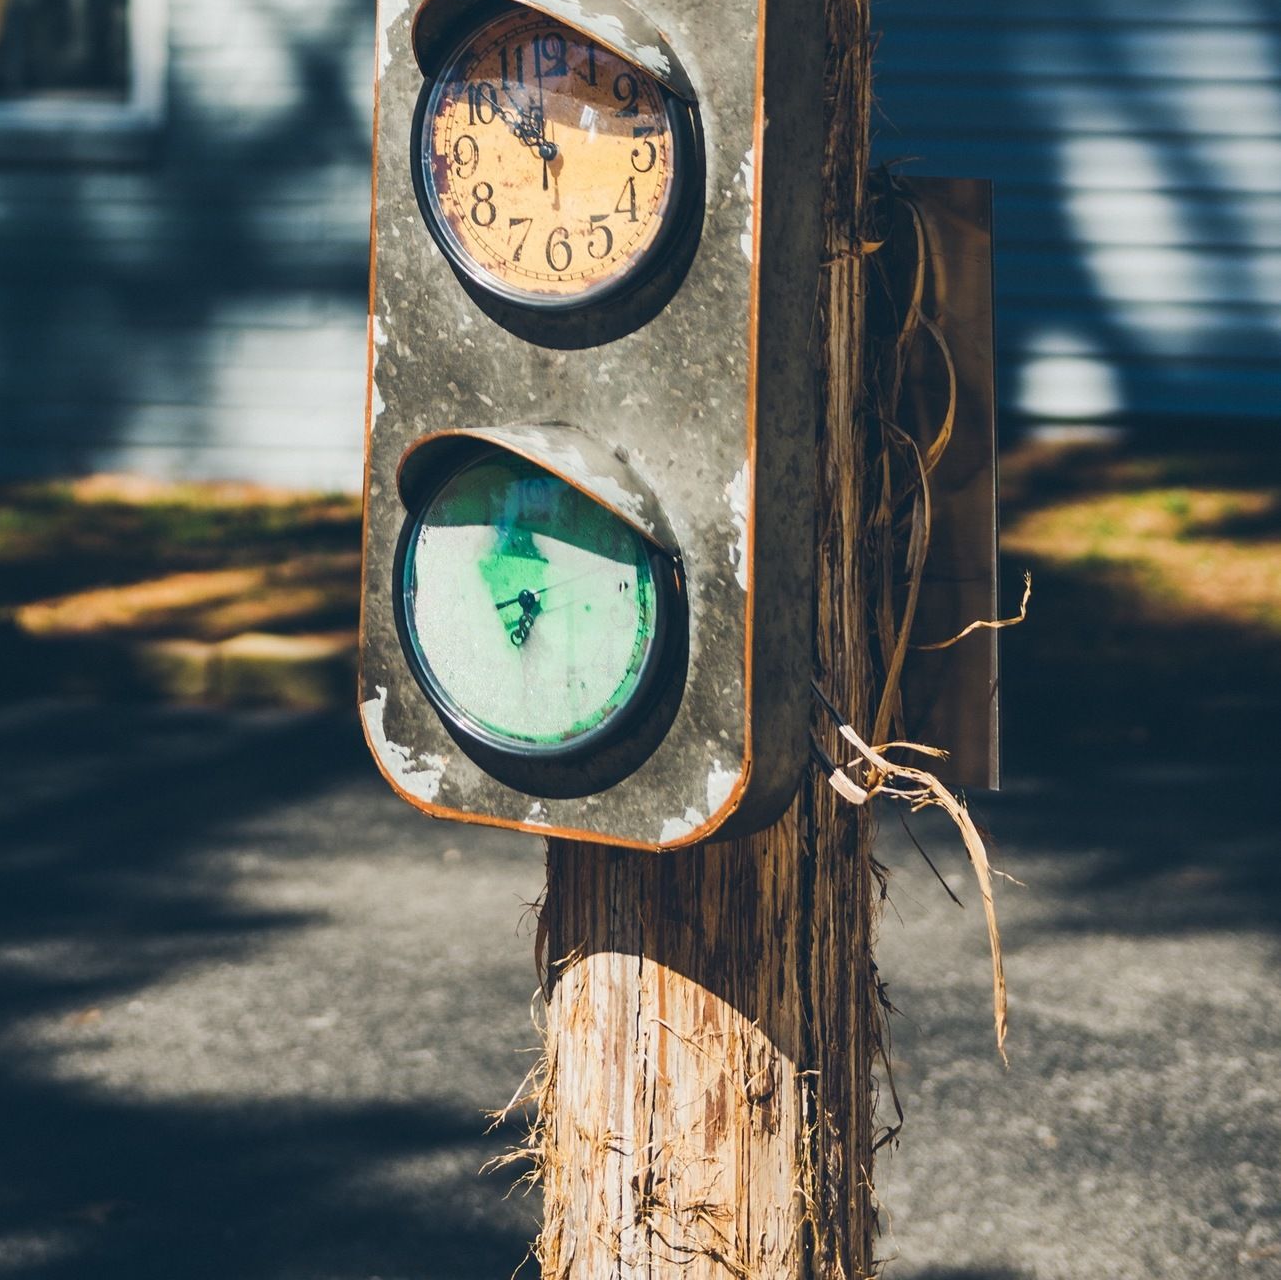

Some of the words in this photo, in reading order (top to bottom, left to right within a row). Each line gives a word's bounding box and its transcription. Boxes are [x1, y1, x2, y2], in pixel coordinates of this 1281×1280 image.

[498, 44, 525, 90] 11
[533, 32, 567, 78] 12
[586, 42, 597, 86] 1
[469, 81, 497, 126] 10
[613, 72, 638, 118] 2
[453, 134, 479, 179] 9
[631, 126, 656, 172] 3
[471, 181, 496, 226] 8
[615, 176, 638, 222] 4
[509, 217, 533, 262] 7
[545, 227, 572, 272] 6
[587, 214, 613, 259] 5
